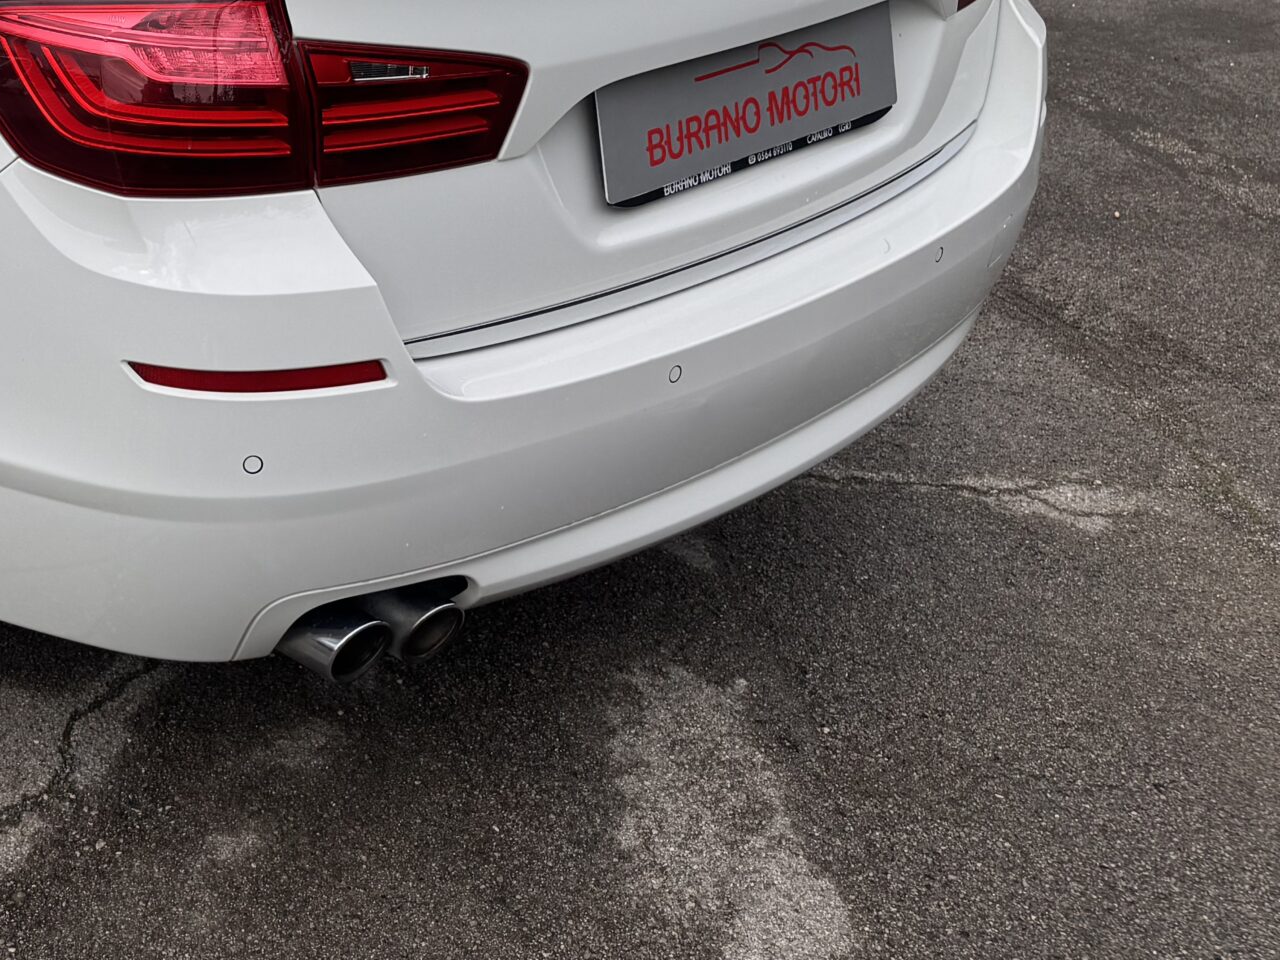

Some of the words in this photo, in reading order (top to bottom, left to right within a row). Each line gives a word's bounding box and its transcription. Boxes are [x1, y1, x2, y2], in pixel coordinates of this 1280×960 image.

[646, 97, 760, 167] BURANO
[766, 62, 861, 127] MOTORI
[663, 175, 699, 195] BURANO
[700, 163, 731, 183] MOTORI
